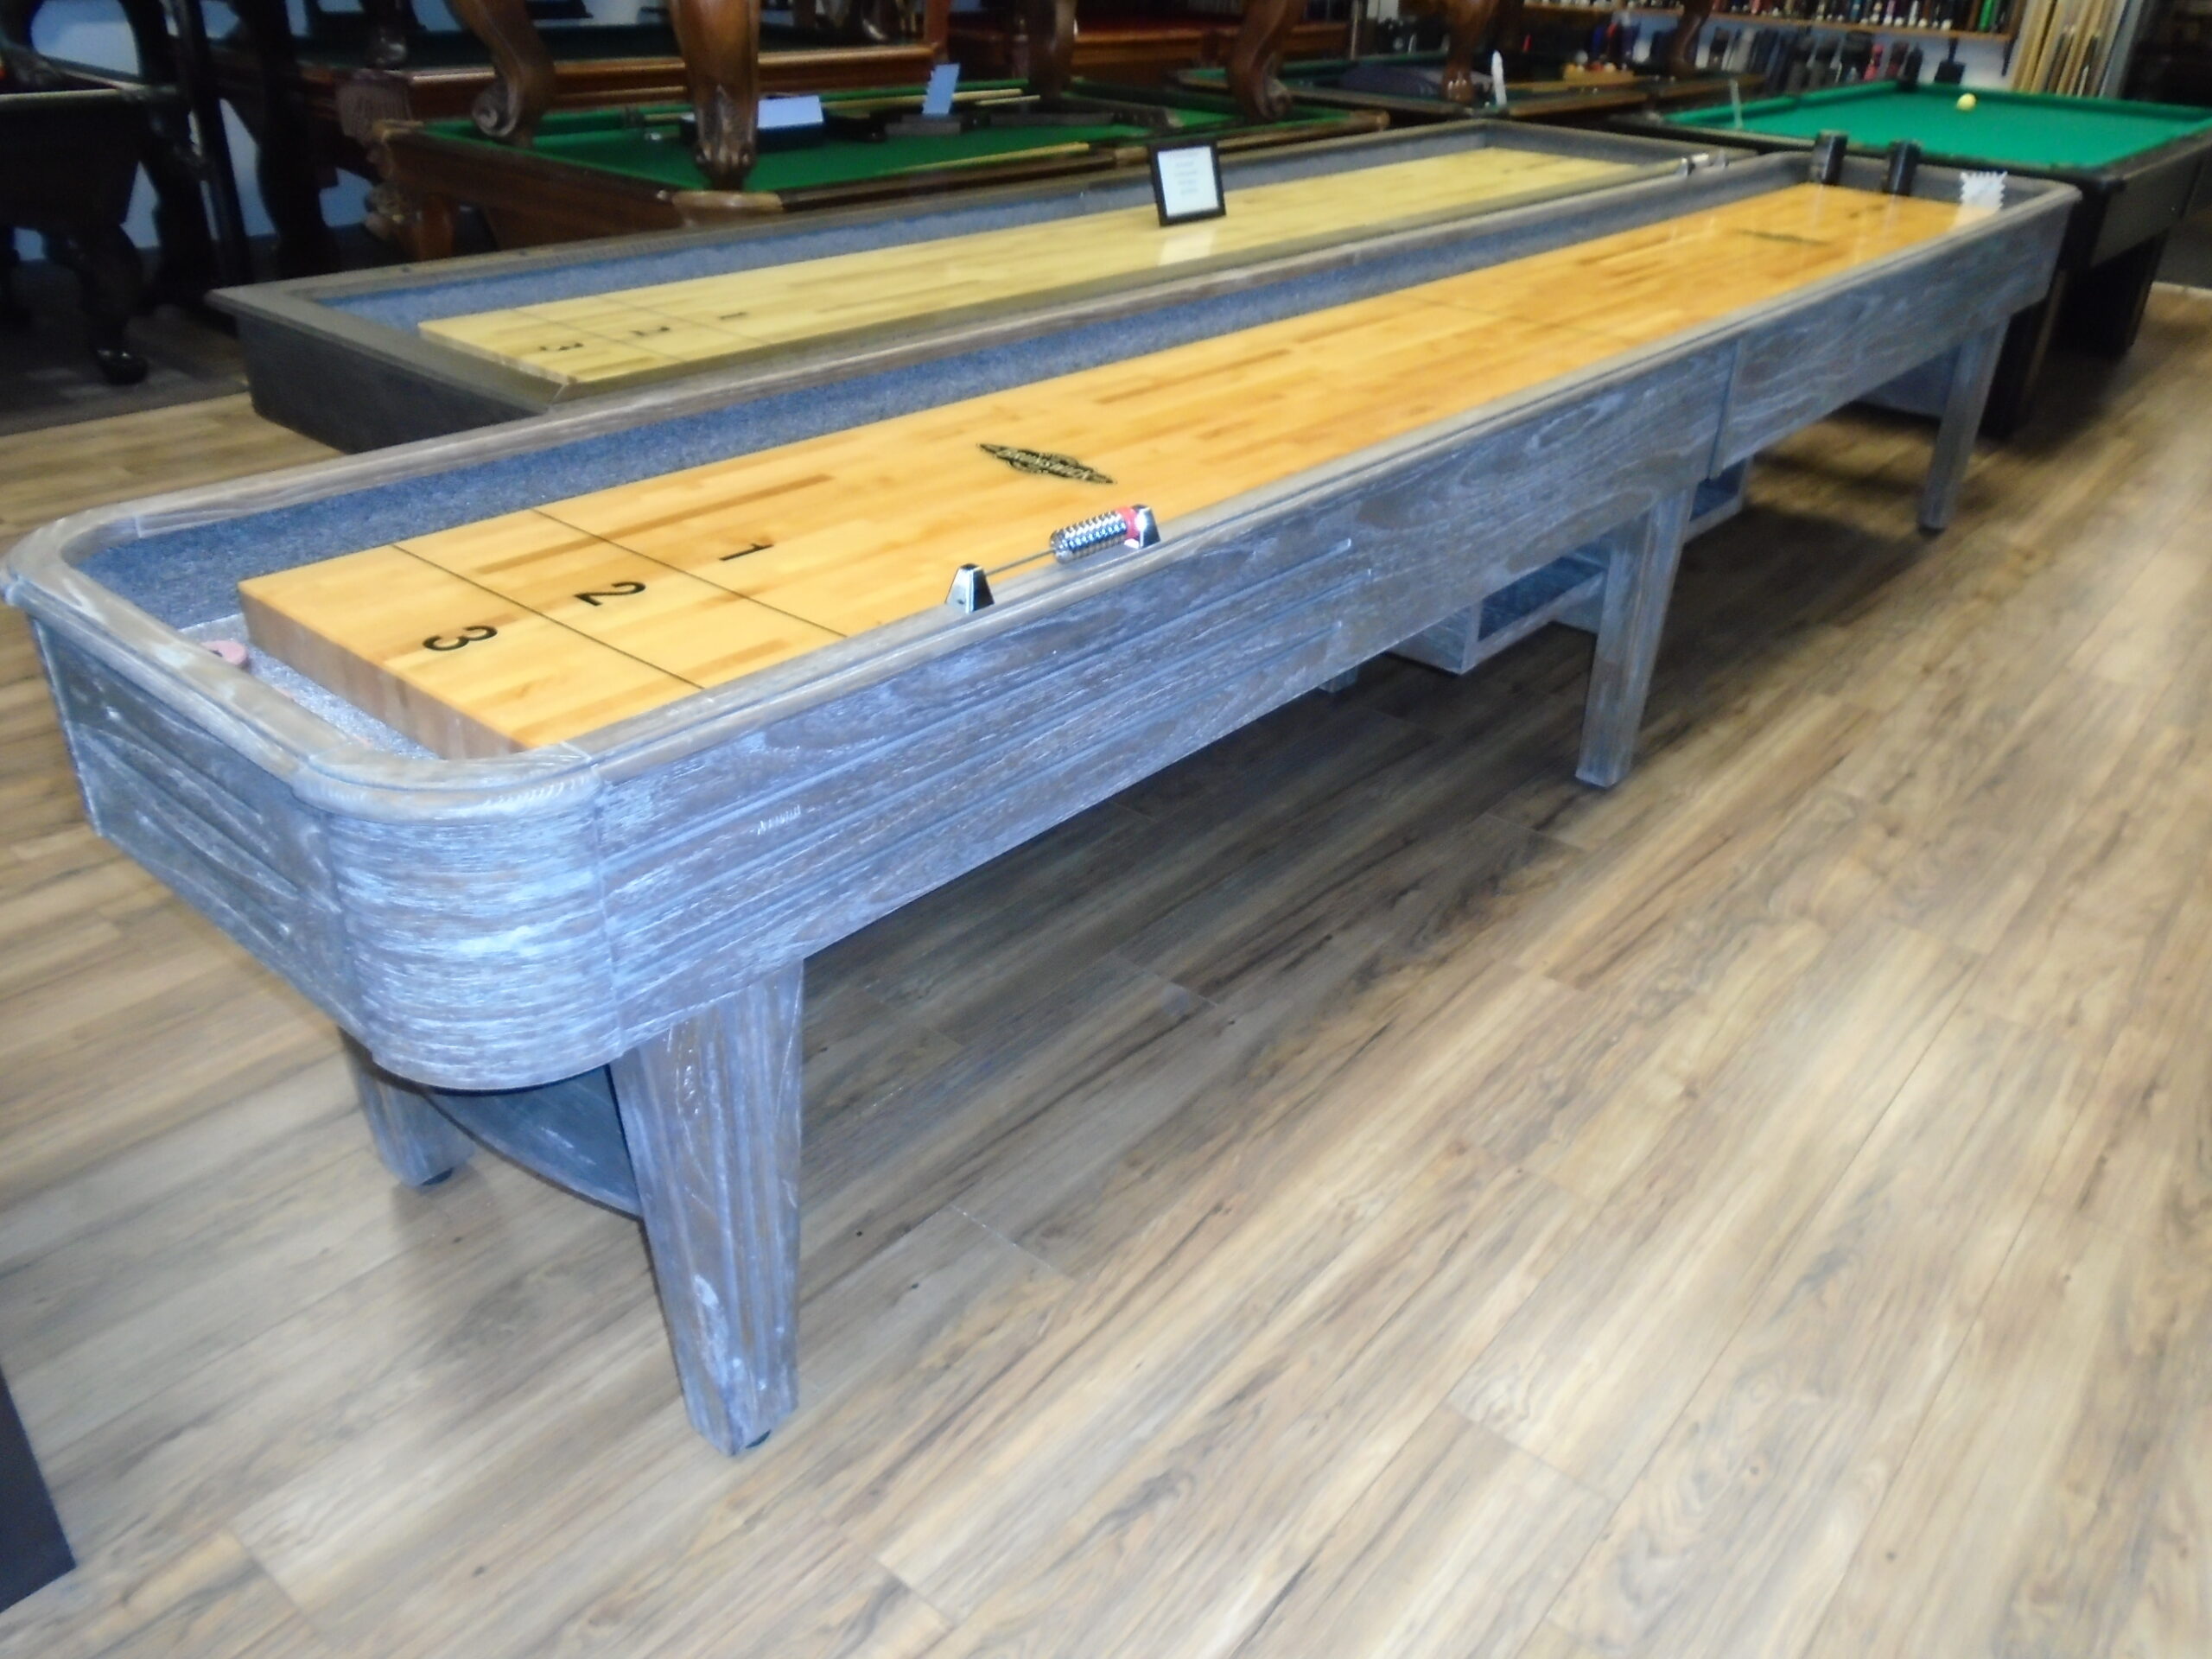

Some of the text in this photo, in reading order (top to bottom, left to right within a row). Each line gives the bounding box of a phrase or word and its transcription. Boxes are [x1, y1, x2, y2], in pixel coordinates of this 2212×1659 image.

[718, 541, 774, 563] 1
[574, 581, 647, 607] 2
[422, 624, 499, 652] 3
